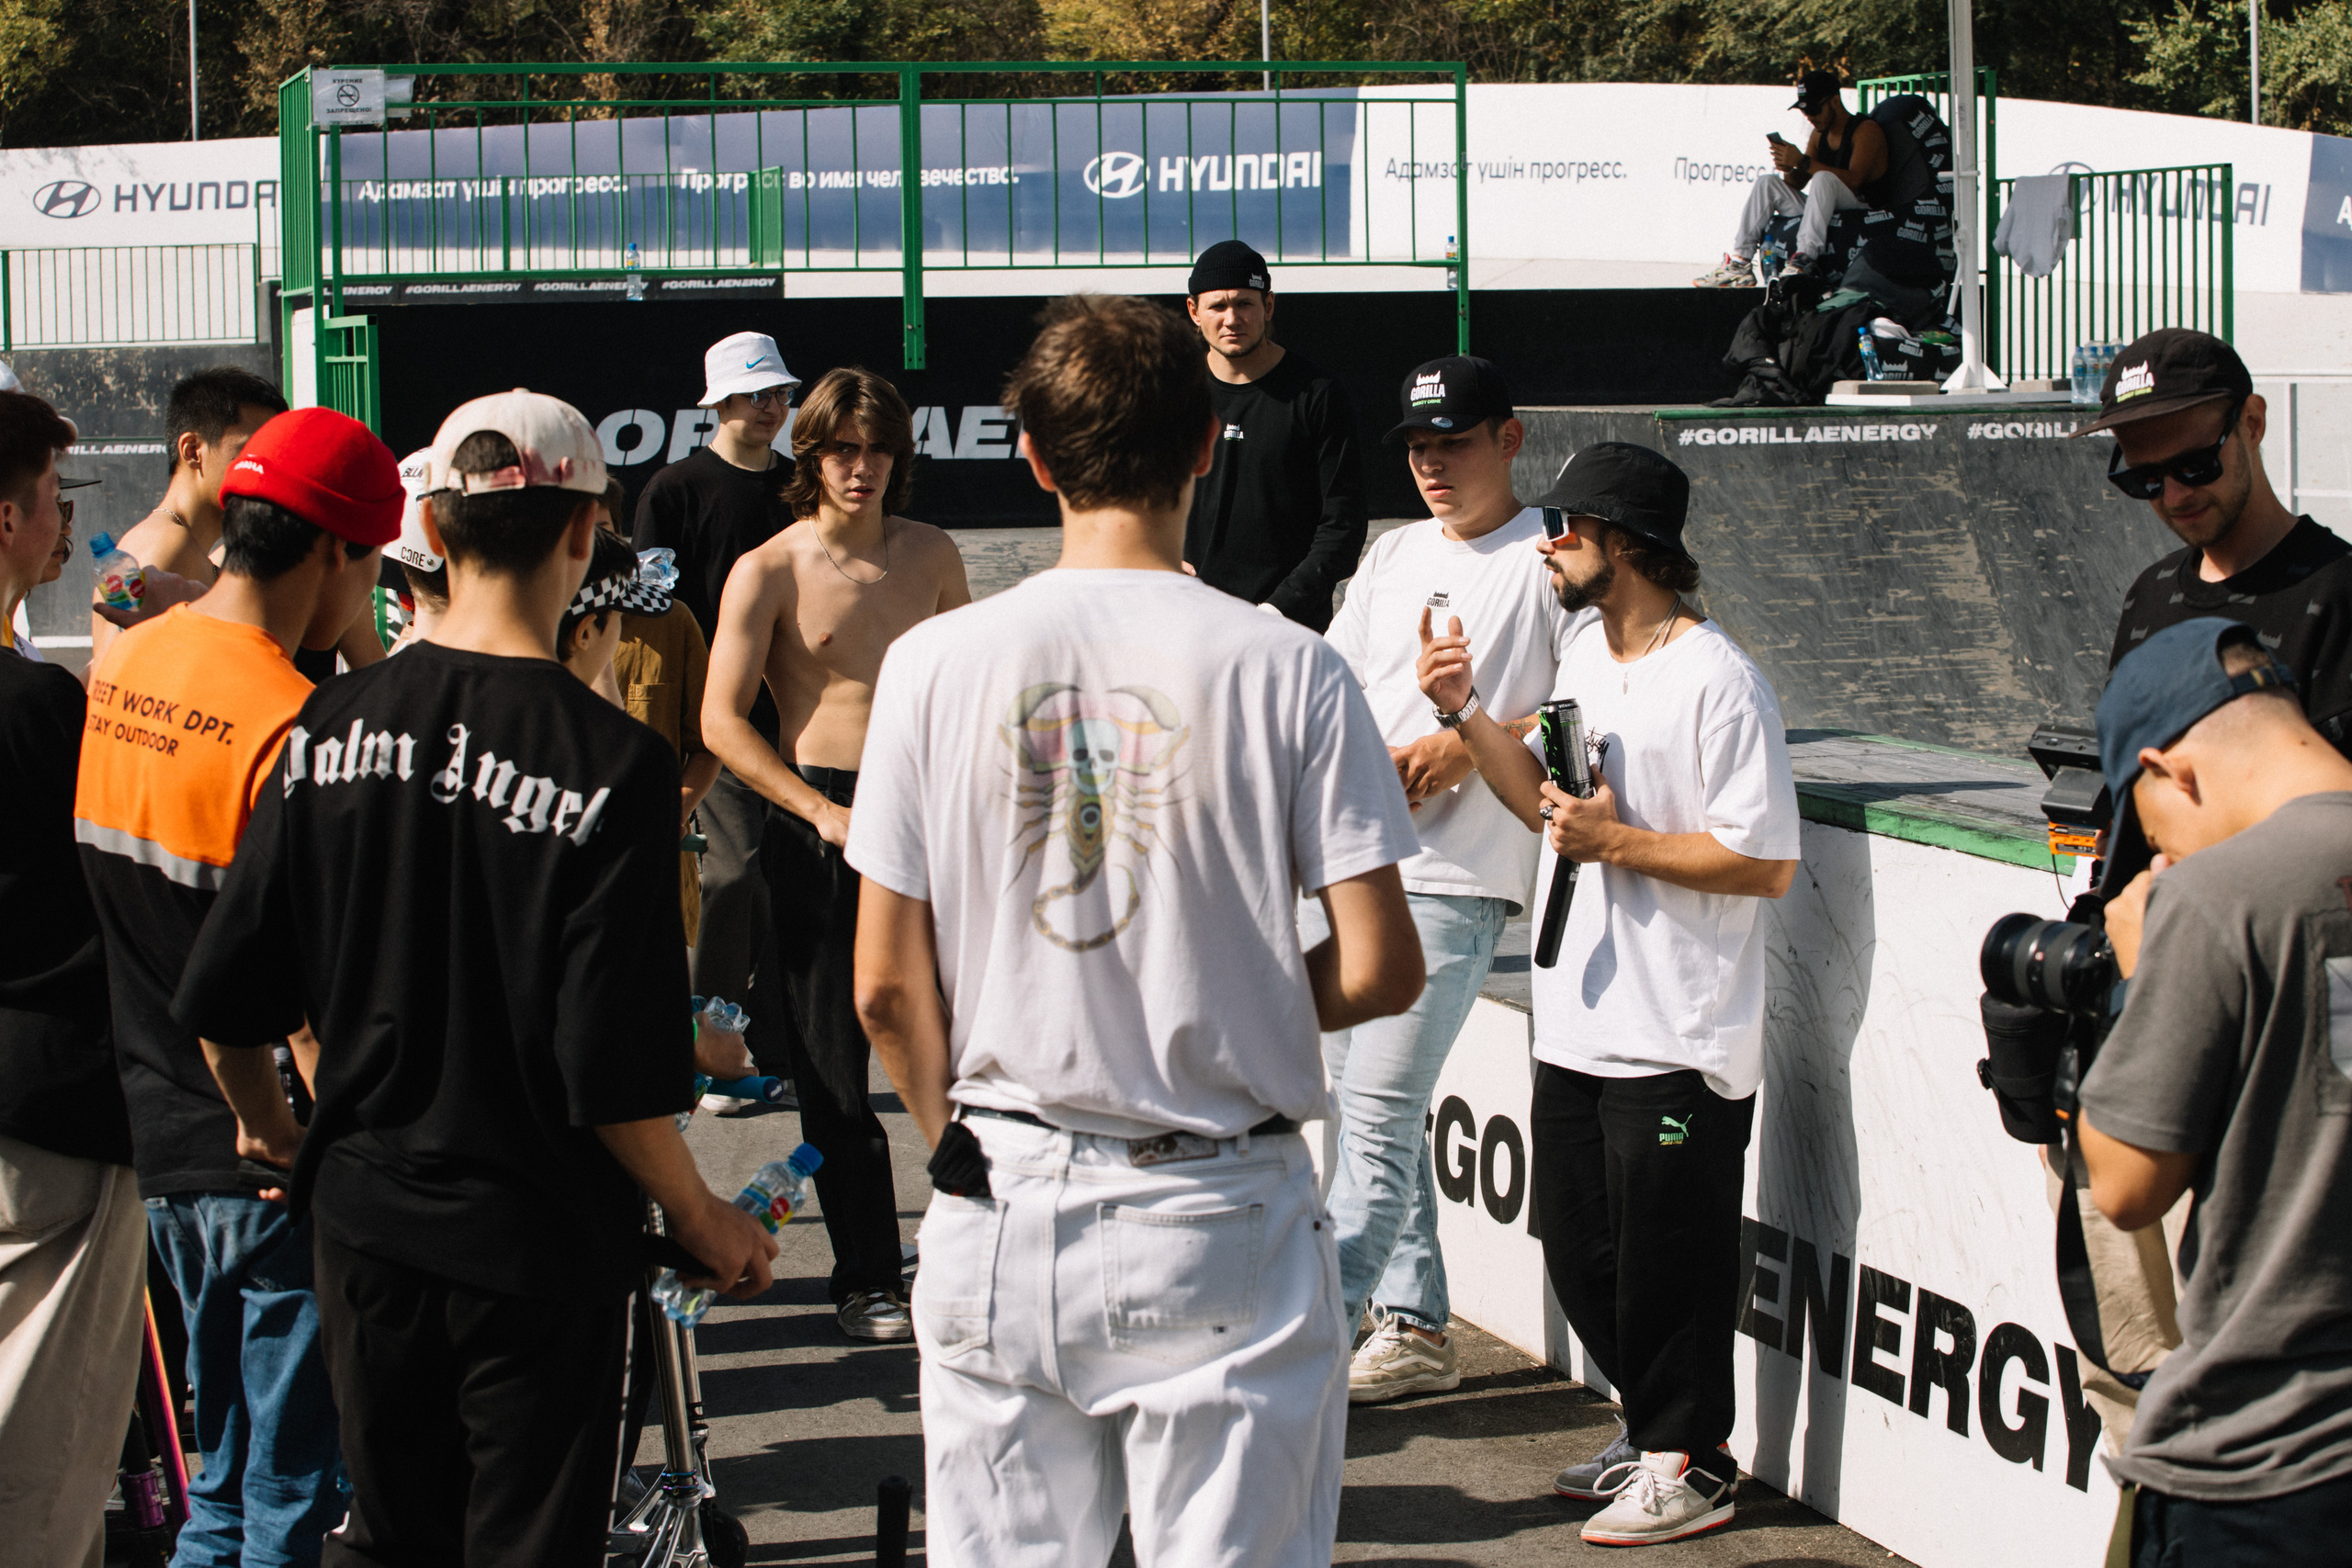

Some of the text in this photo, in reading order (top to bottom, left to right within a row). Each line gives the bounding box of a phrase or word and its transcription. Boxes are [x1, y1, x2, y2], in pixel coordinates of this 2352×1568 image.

[1159, 151, 1322, 193] HYUNDAI
[1529, 161, 1627, 184] прогресс.
[114, 180, 277, 212] HYUNDA
[1864, 211, 1894, 224] GORILLA
[1914, 205, 1947, 217] GORILLA
[1896, 227, 1928, 244] GORILLA
[1410, 383, 1446, 401] GORILLA
[1678, 423, 1938, 446] #GORILLAENERGY
[1426, 597, 1451, 607] GORILLA
[122, 690, 180, 724] WORK
[183, 709, 234, 745] DPT.
[114, 722, 178, 757] OUTDOOR
[1659, 1133, 1684, 1142] PUMA
[1735, 1215, 2102, 1494] ENERGY
